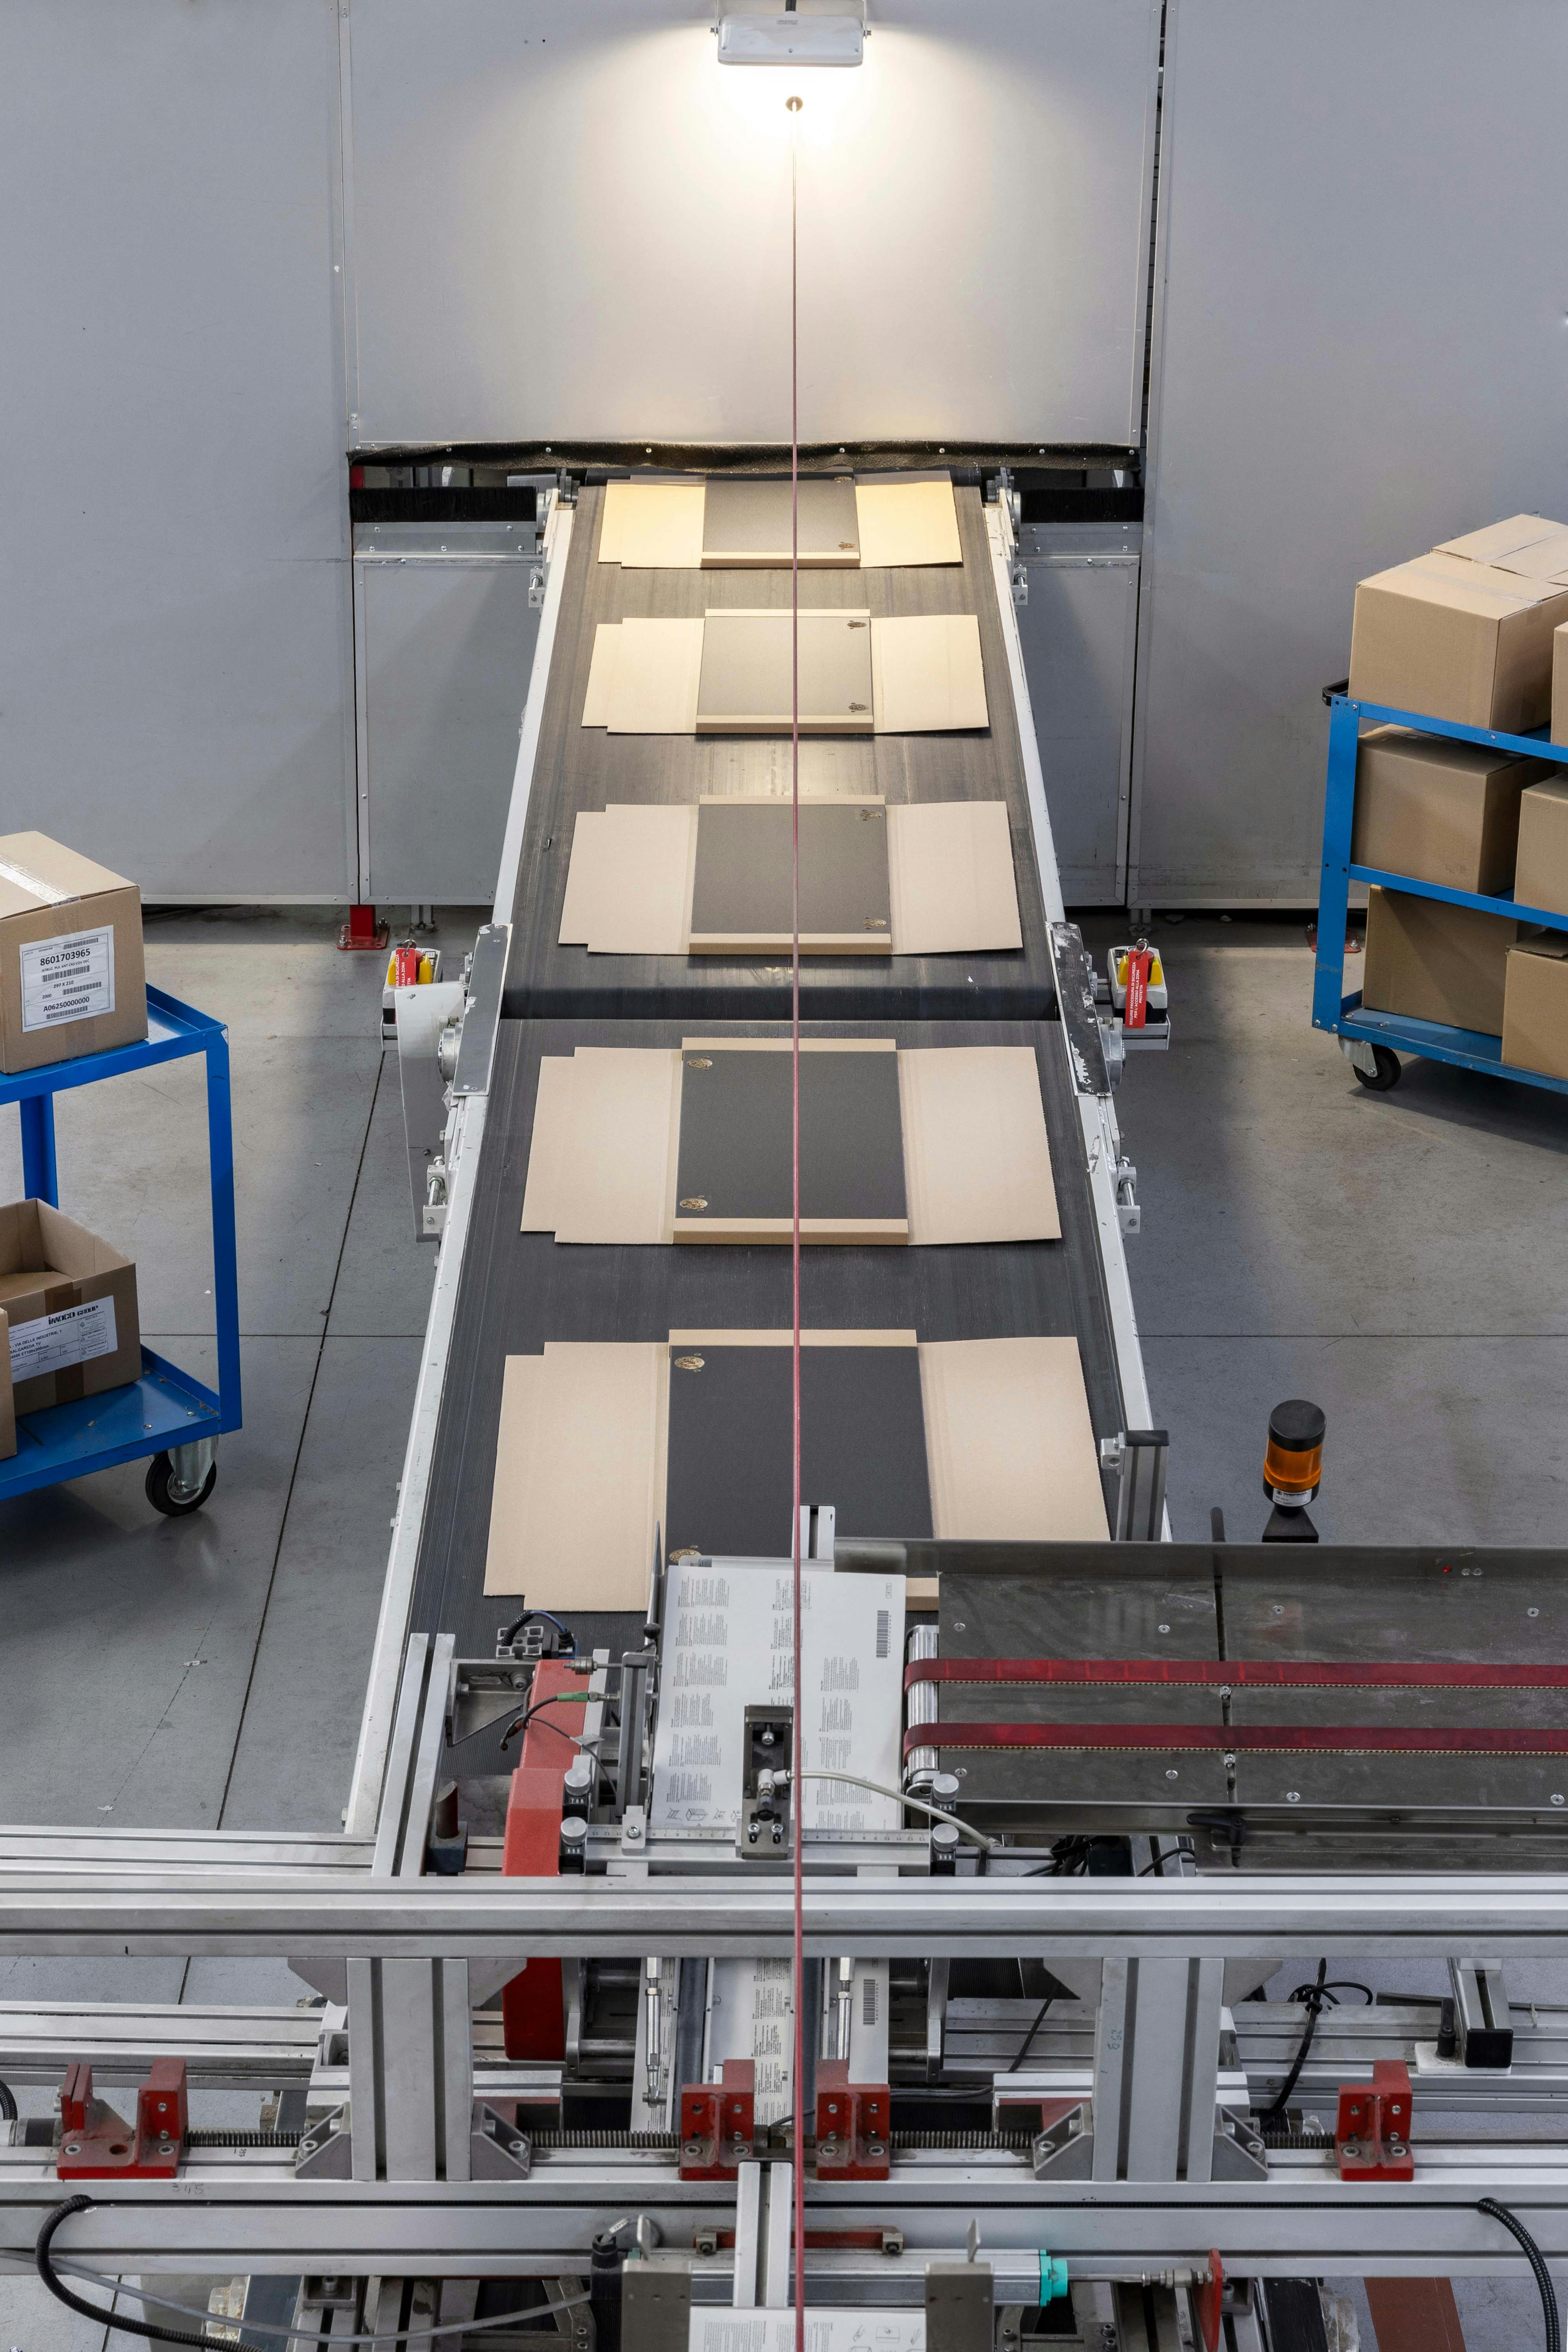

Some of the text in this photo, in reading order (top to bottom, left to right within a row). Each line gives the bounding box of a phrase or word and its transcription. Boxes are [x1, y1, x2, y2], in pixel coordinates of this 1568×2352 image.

[40, 948, 90, 966] 8601703965
[43, 996, 90, 1012] A06250000000
[77, 1305, 98, 1316] GROUP
[10, 1344, 35, 1354] SALGAREDA
